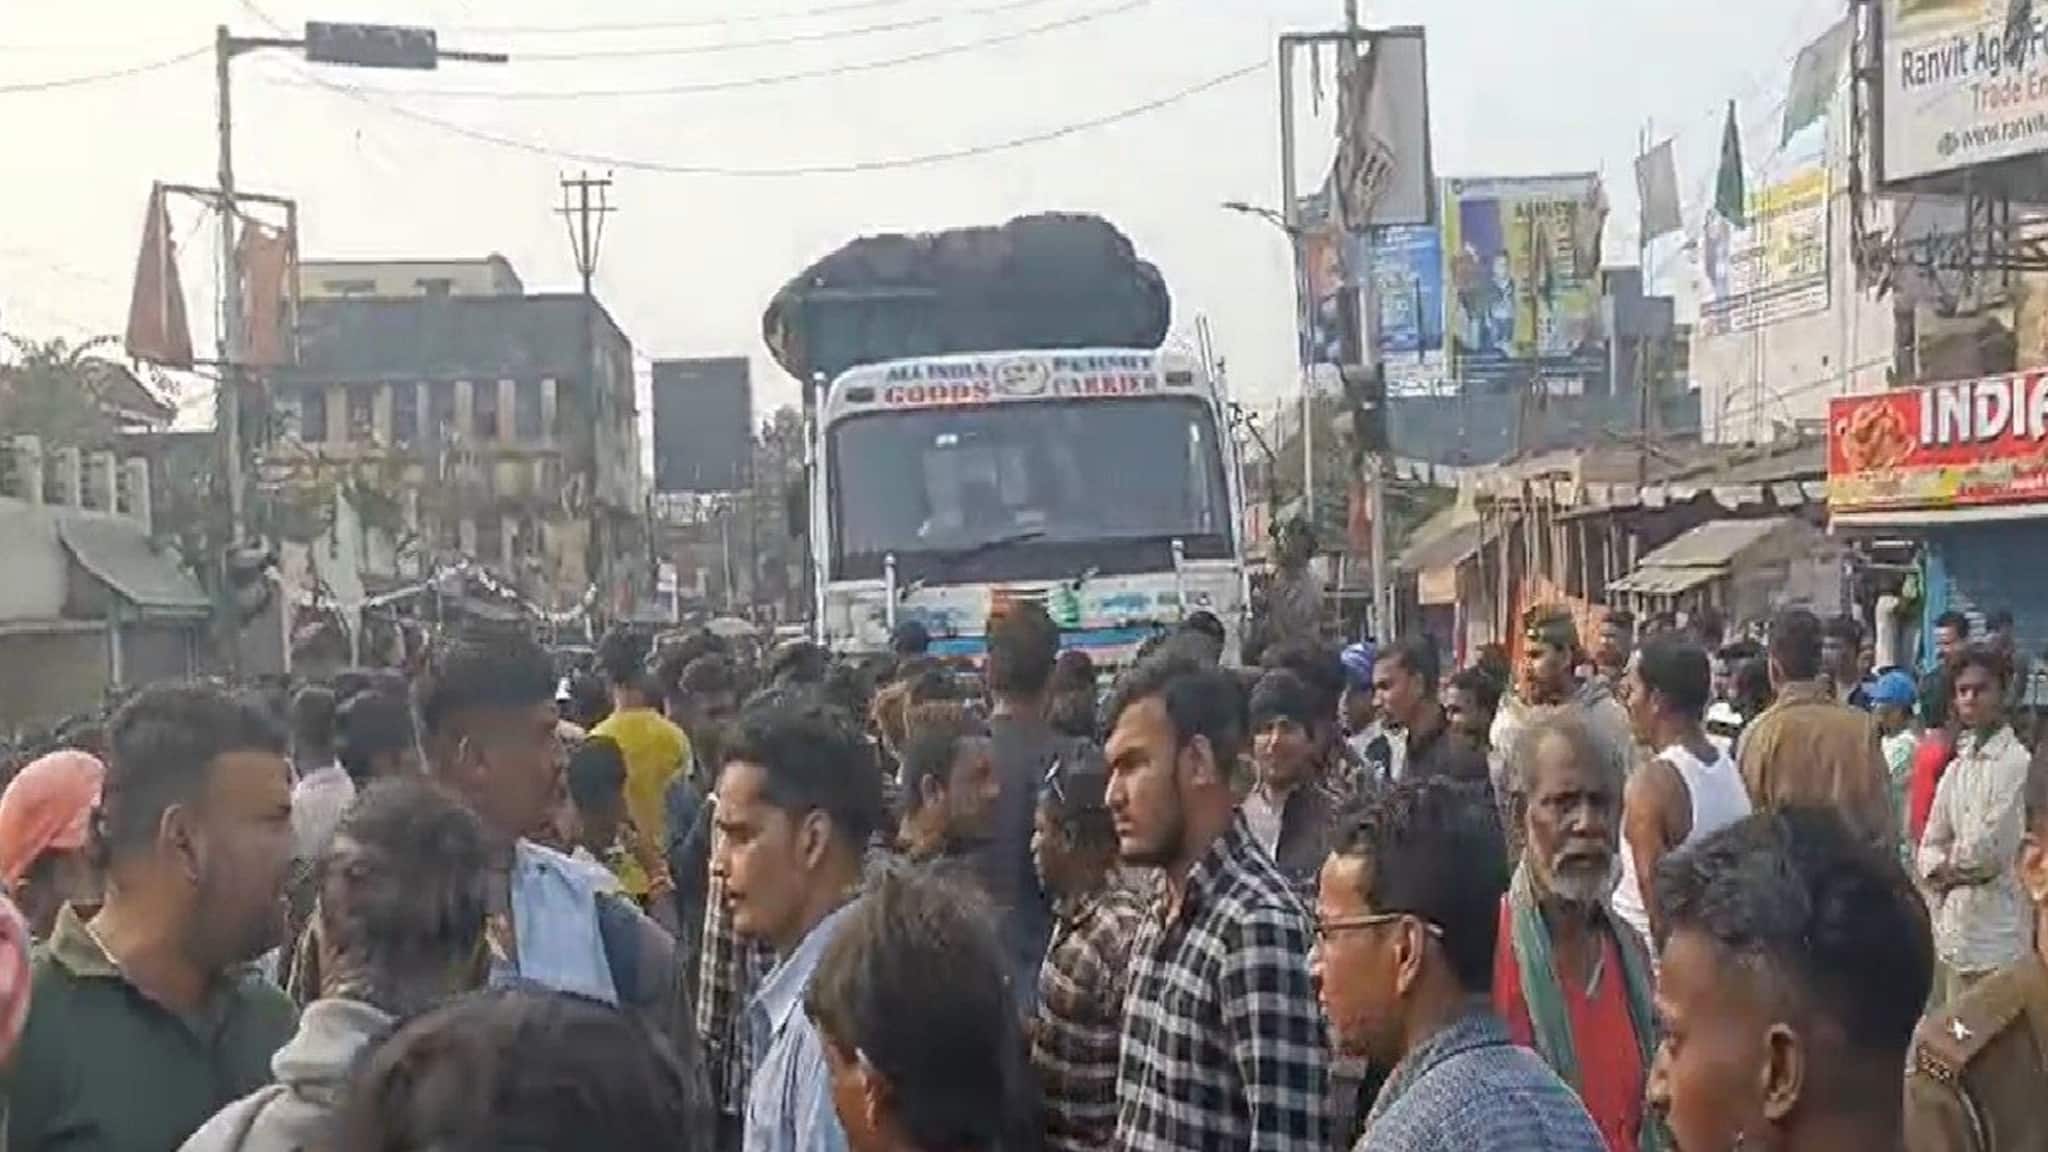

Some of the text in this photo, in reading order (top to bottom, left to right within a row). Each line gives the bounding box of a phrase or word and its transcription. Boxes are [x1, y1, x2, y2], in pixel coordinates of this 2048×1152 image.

[1902, 36, 1968, 89] Ranvit
[1970, 77, 2020, 112] Trade
[887, 364, 924, 381] ALL
[928, 362, 988, 380] INDIA
[885, 381, 990, 402] GOODS
[1053, 375, 1157, 393] CARRIER
